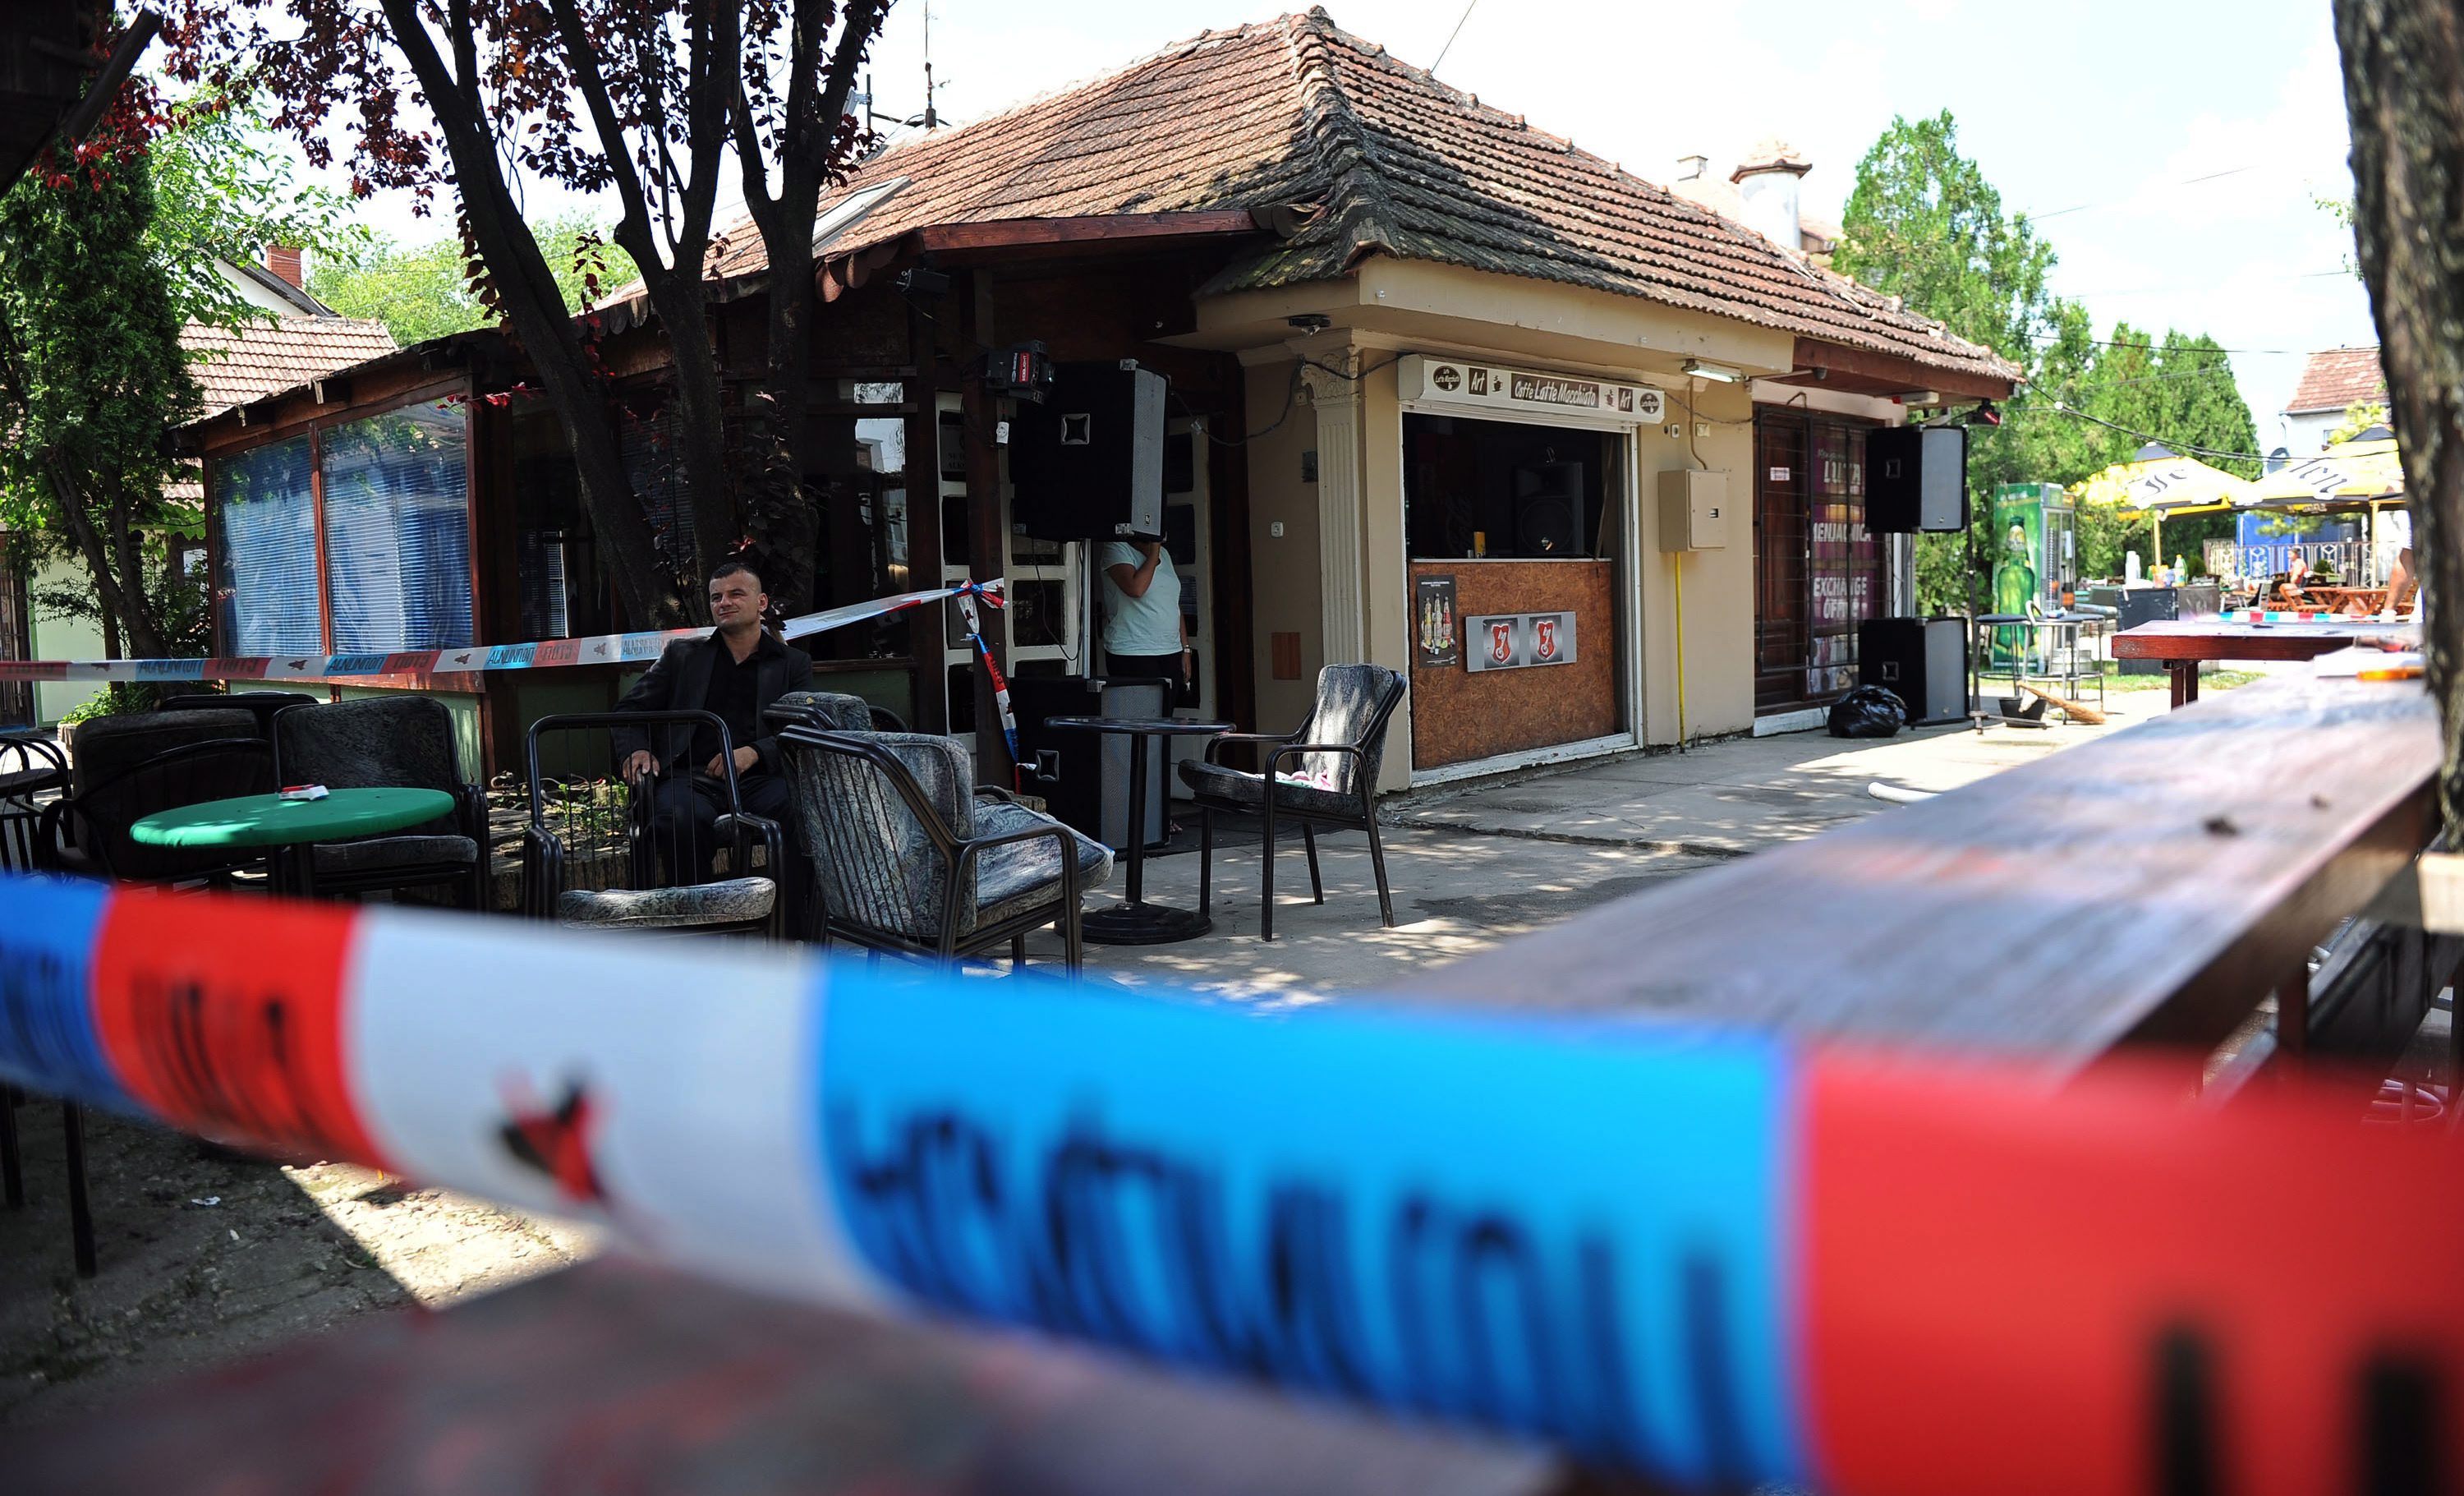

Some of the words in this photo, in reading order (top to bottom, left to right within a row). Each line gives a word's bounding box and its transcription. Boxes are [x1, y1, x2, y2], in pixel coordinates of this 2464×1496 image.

[1470, 371, 1486, 392] Art
[1515, 380, 1533, 398] Caffe
[1534, 380, 1557, 402] Latte
[1557, 383, 1596, 406] Macchiato
